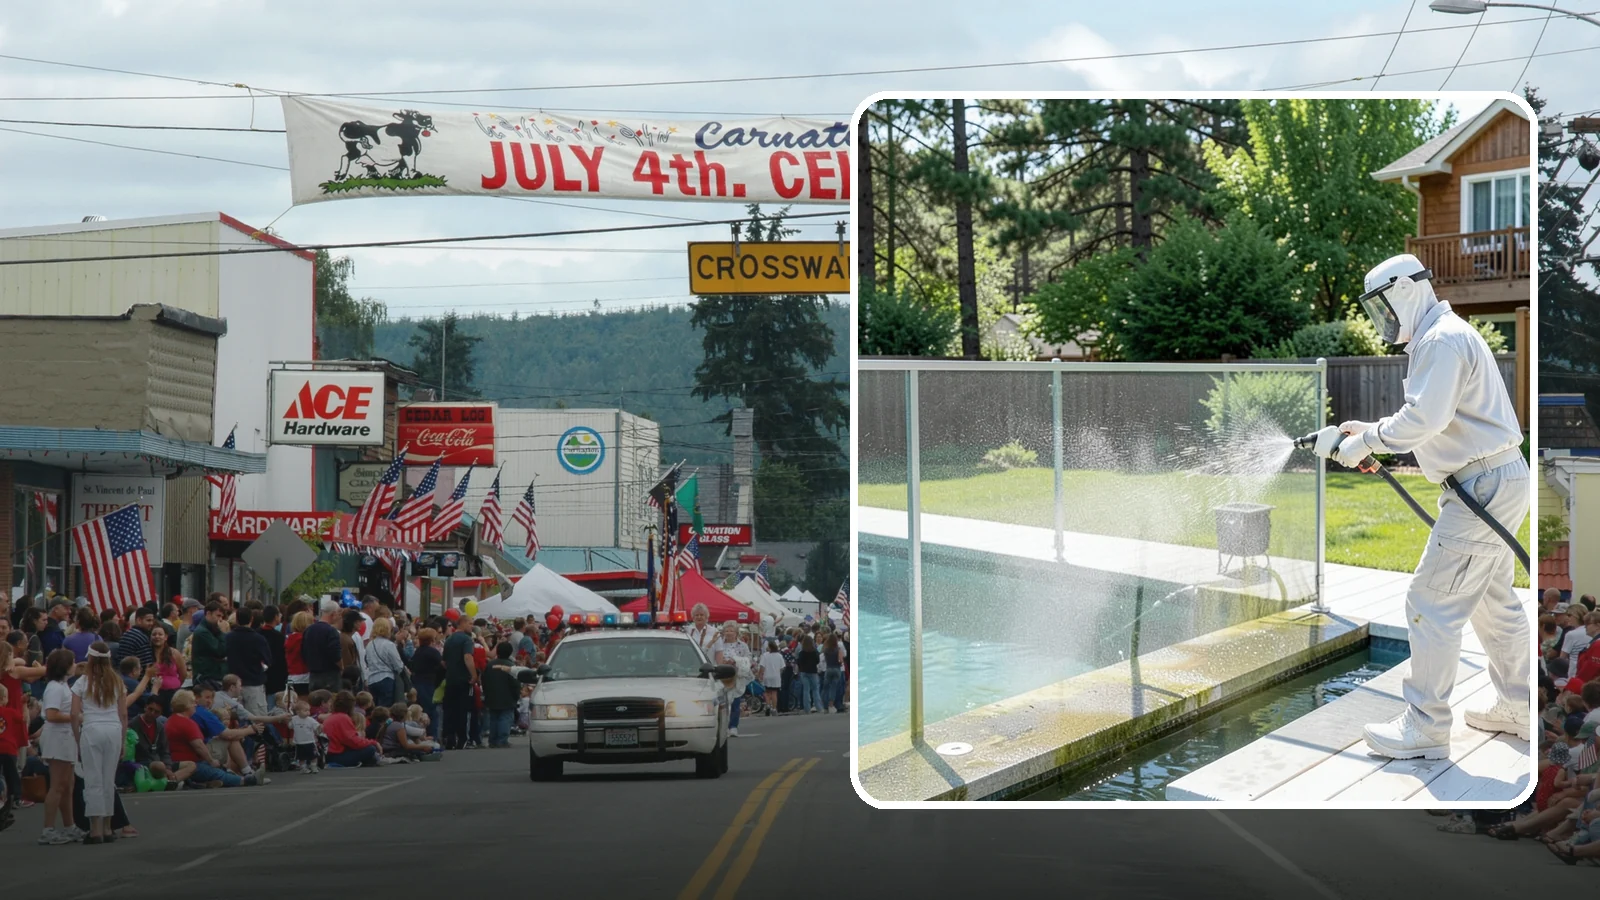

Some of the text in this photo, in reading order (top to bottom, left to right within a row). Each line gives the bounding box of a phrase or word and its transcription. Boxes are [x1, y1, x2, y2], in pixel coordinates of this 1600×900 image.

[695, 121, 850, 150] Carnat
[481, 141, 605, 193] JULY
[632, 150, 746, 197] 4th.
[697, 254, 850, 280] CROSSWA
[283, 380, 374, 420] ACE
[406, 409, 452, 422] CEDAR
[283, 421, 371, 437] Hardware
[416, 428, 478, 447] Coca-Cola
[353, 467, 386, 480] Simpl
[95, 484, 124, 495] Vincent
[126, 486, 136, 495] de
[137, 486, 155, 495] Paul
[688, 526, 741, 535] CRNATION
[699, 535, 730, 543] GLASS
